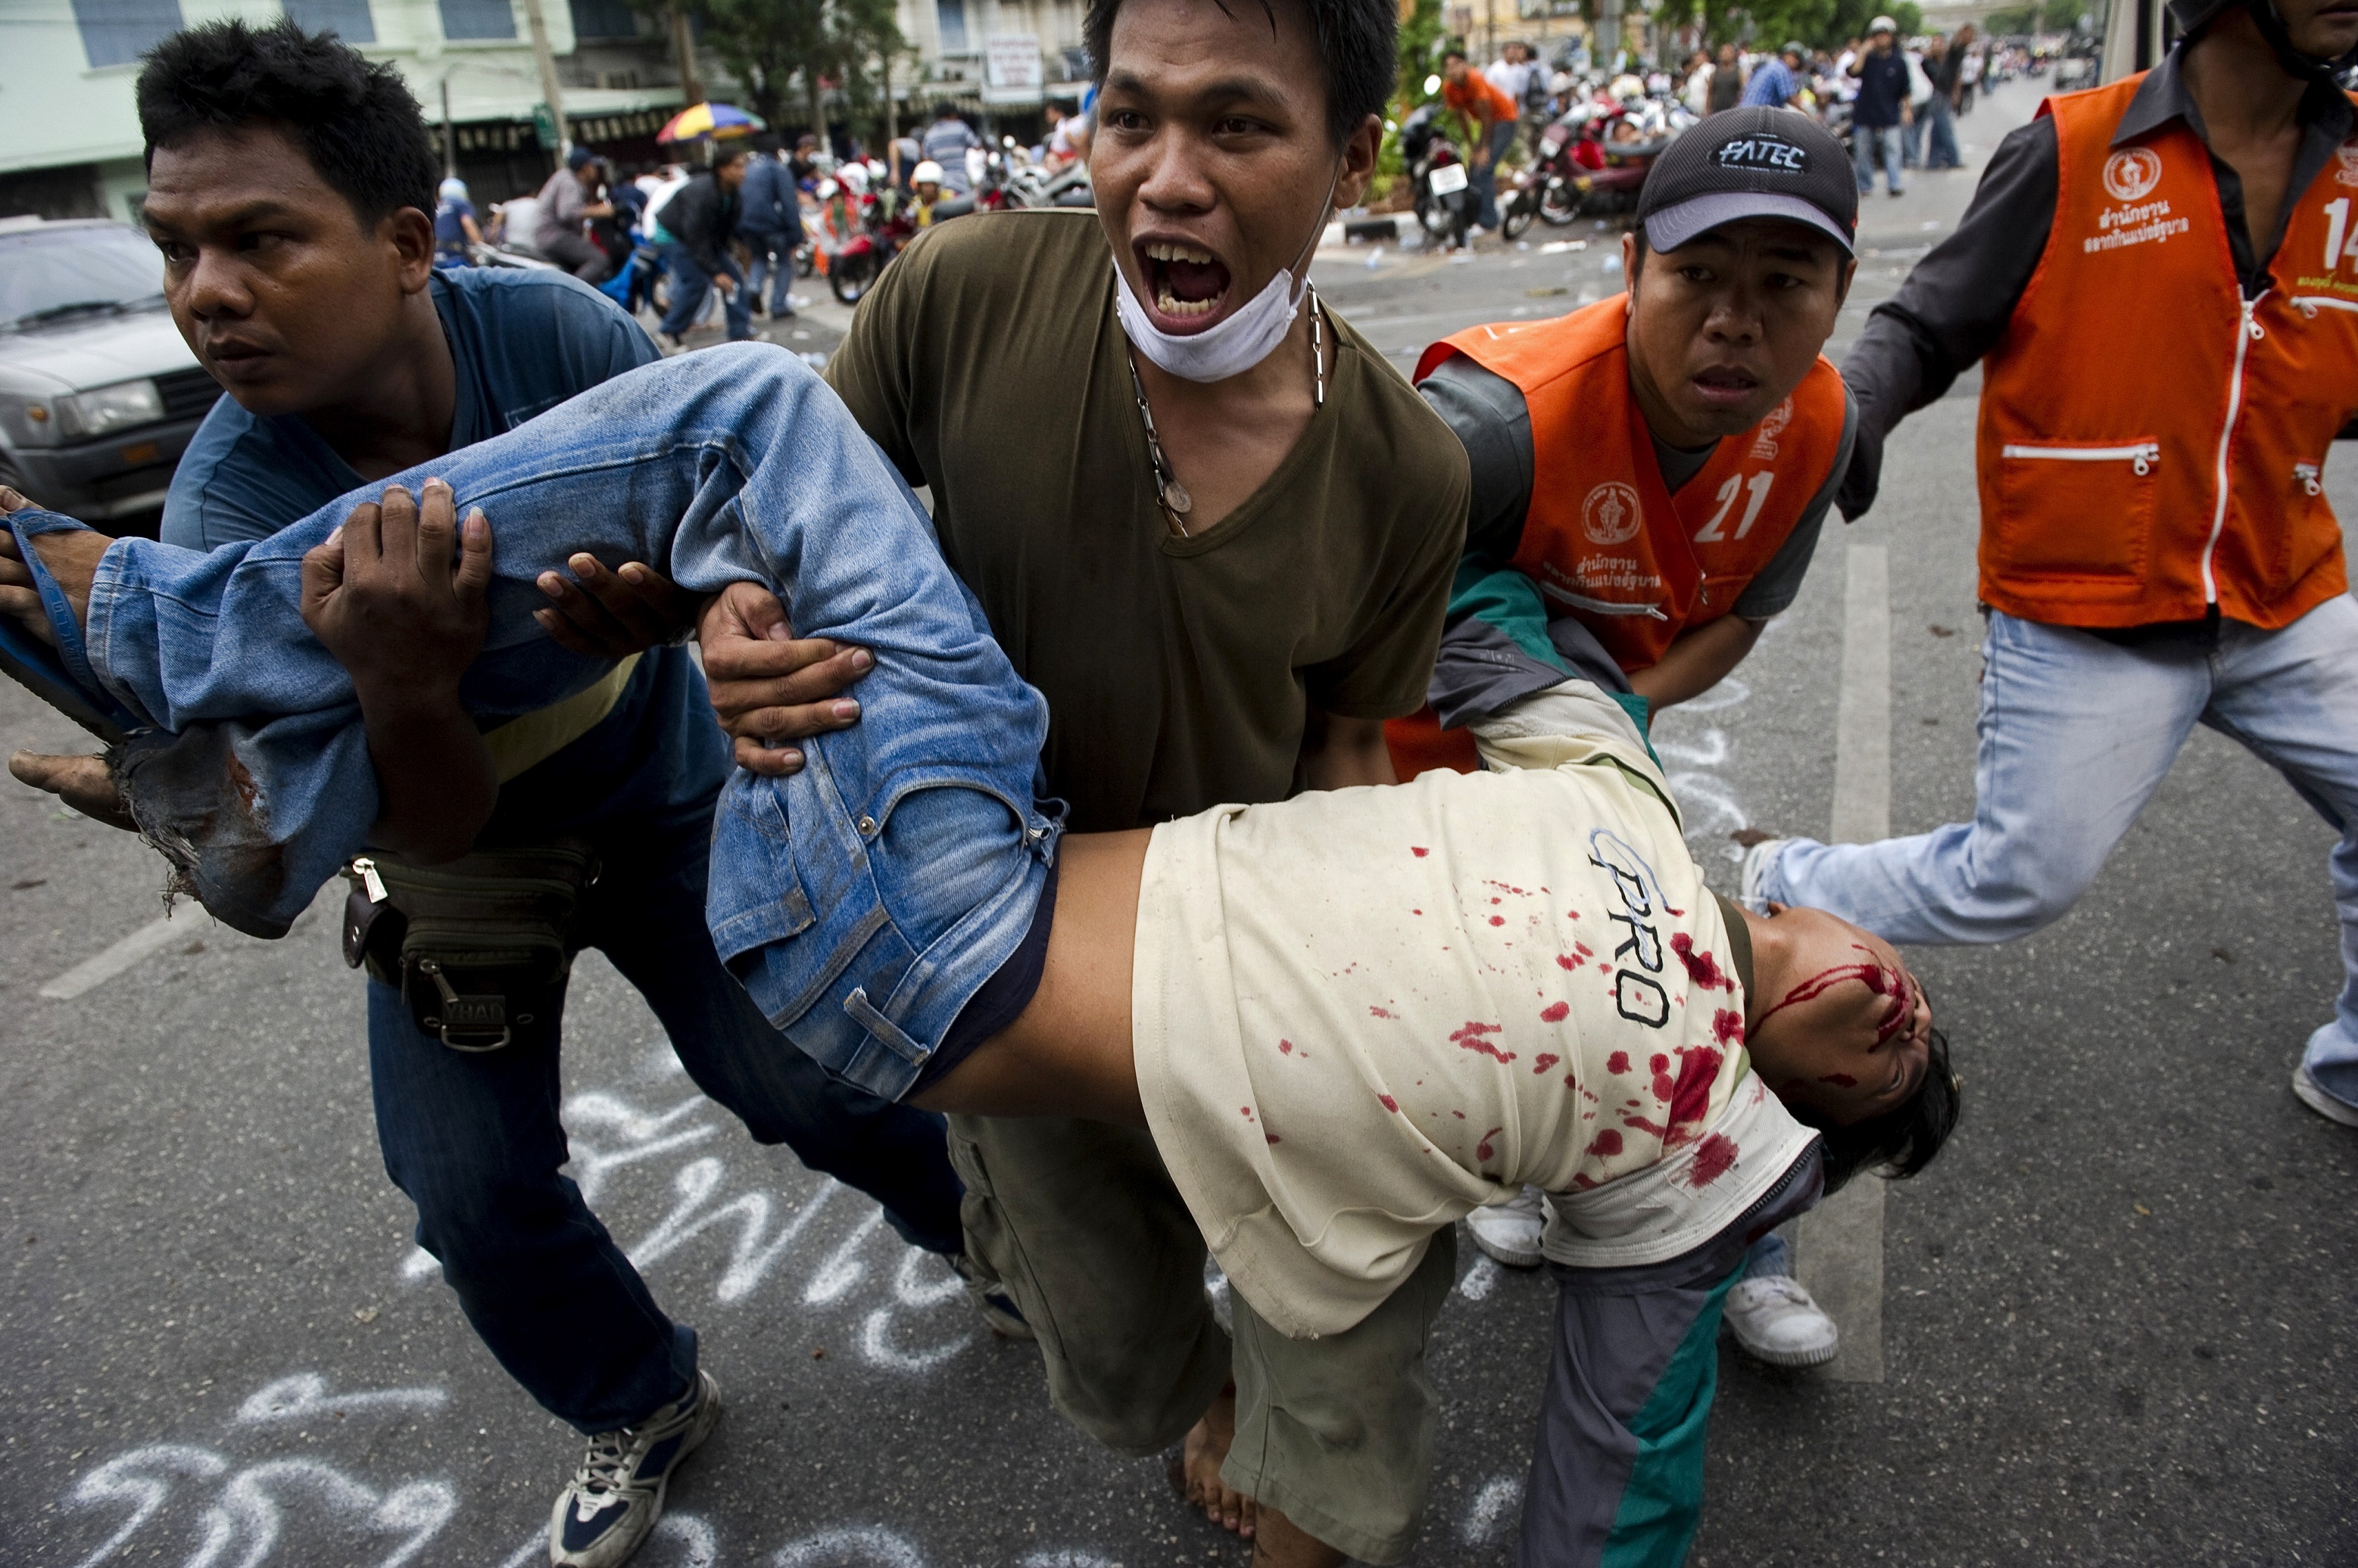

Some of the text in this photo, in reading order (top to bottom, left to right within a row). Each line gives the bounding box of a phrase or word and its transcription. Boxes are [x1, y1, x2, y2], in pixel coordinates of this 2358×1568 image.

[1719, 139, 1806, 169] FATEC
[2099, 199, 2171, 230] สำนักงาน
[1693, 469, 1775, 543] 21
[1576, 552, 1638, 575] สำนักงาน
